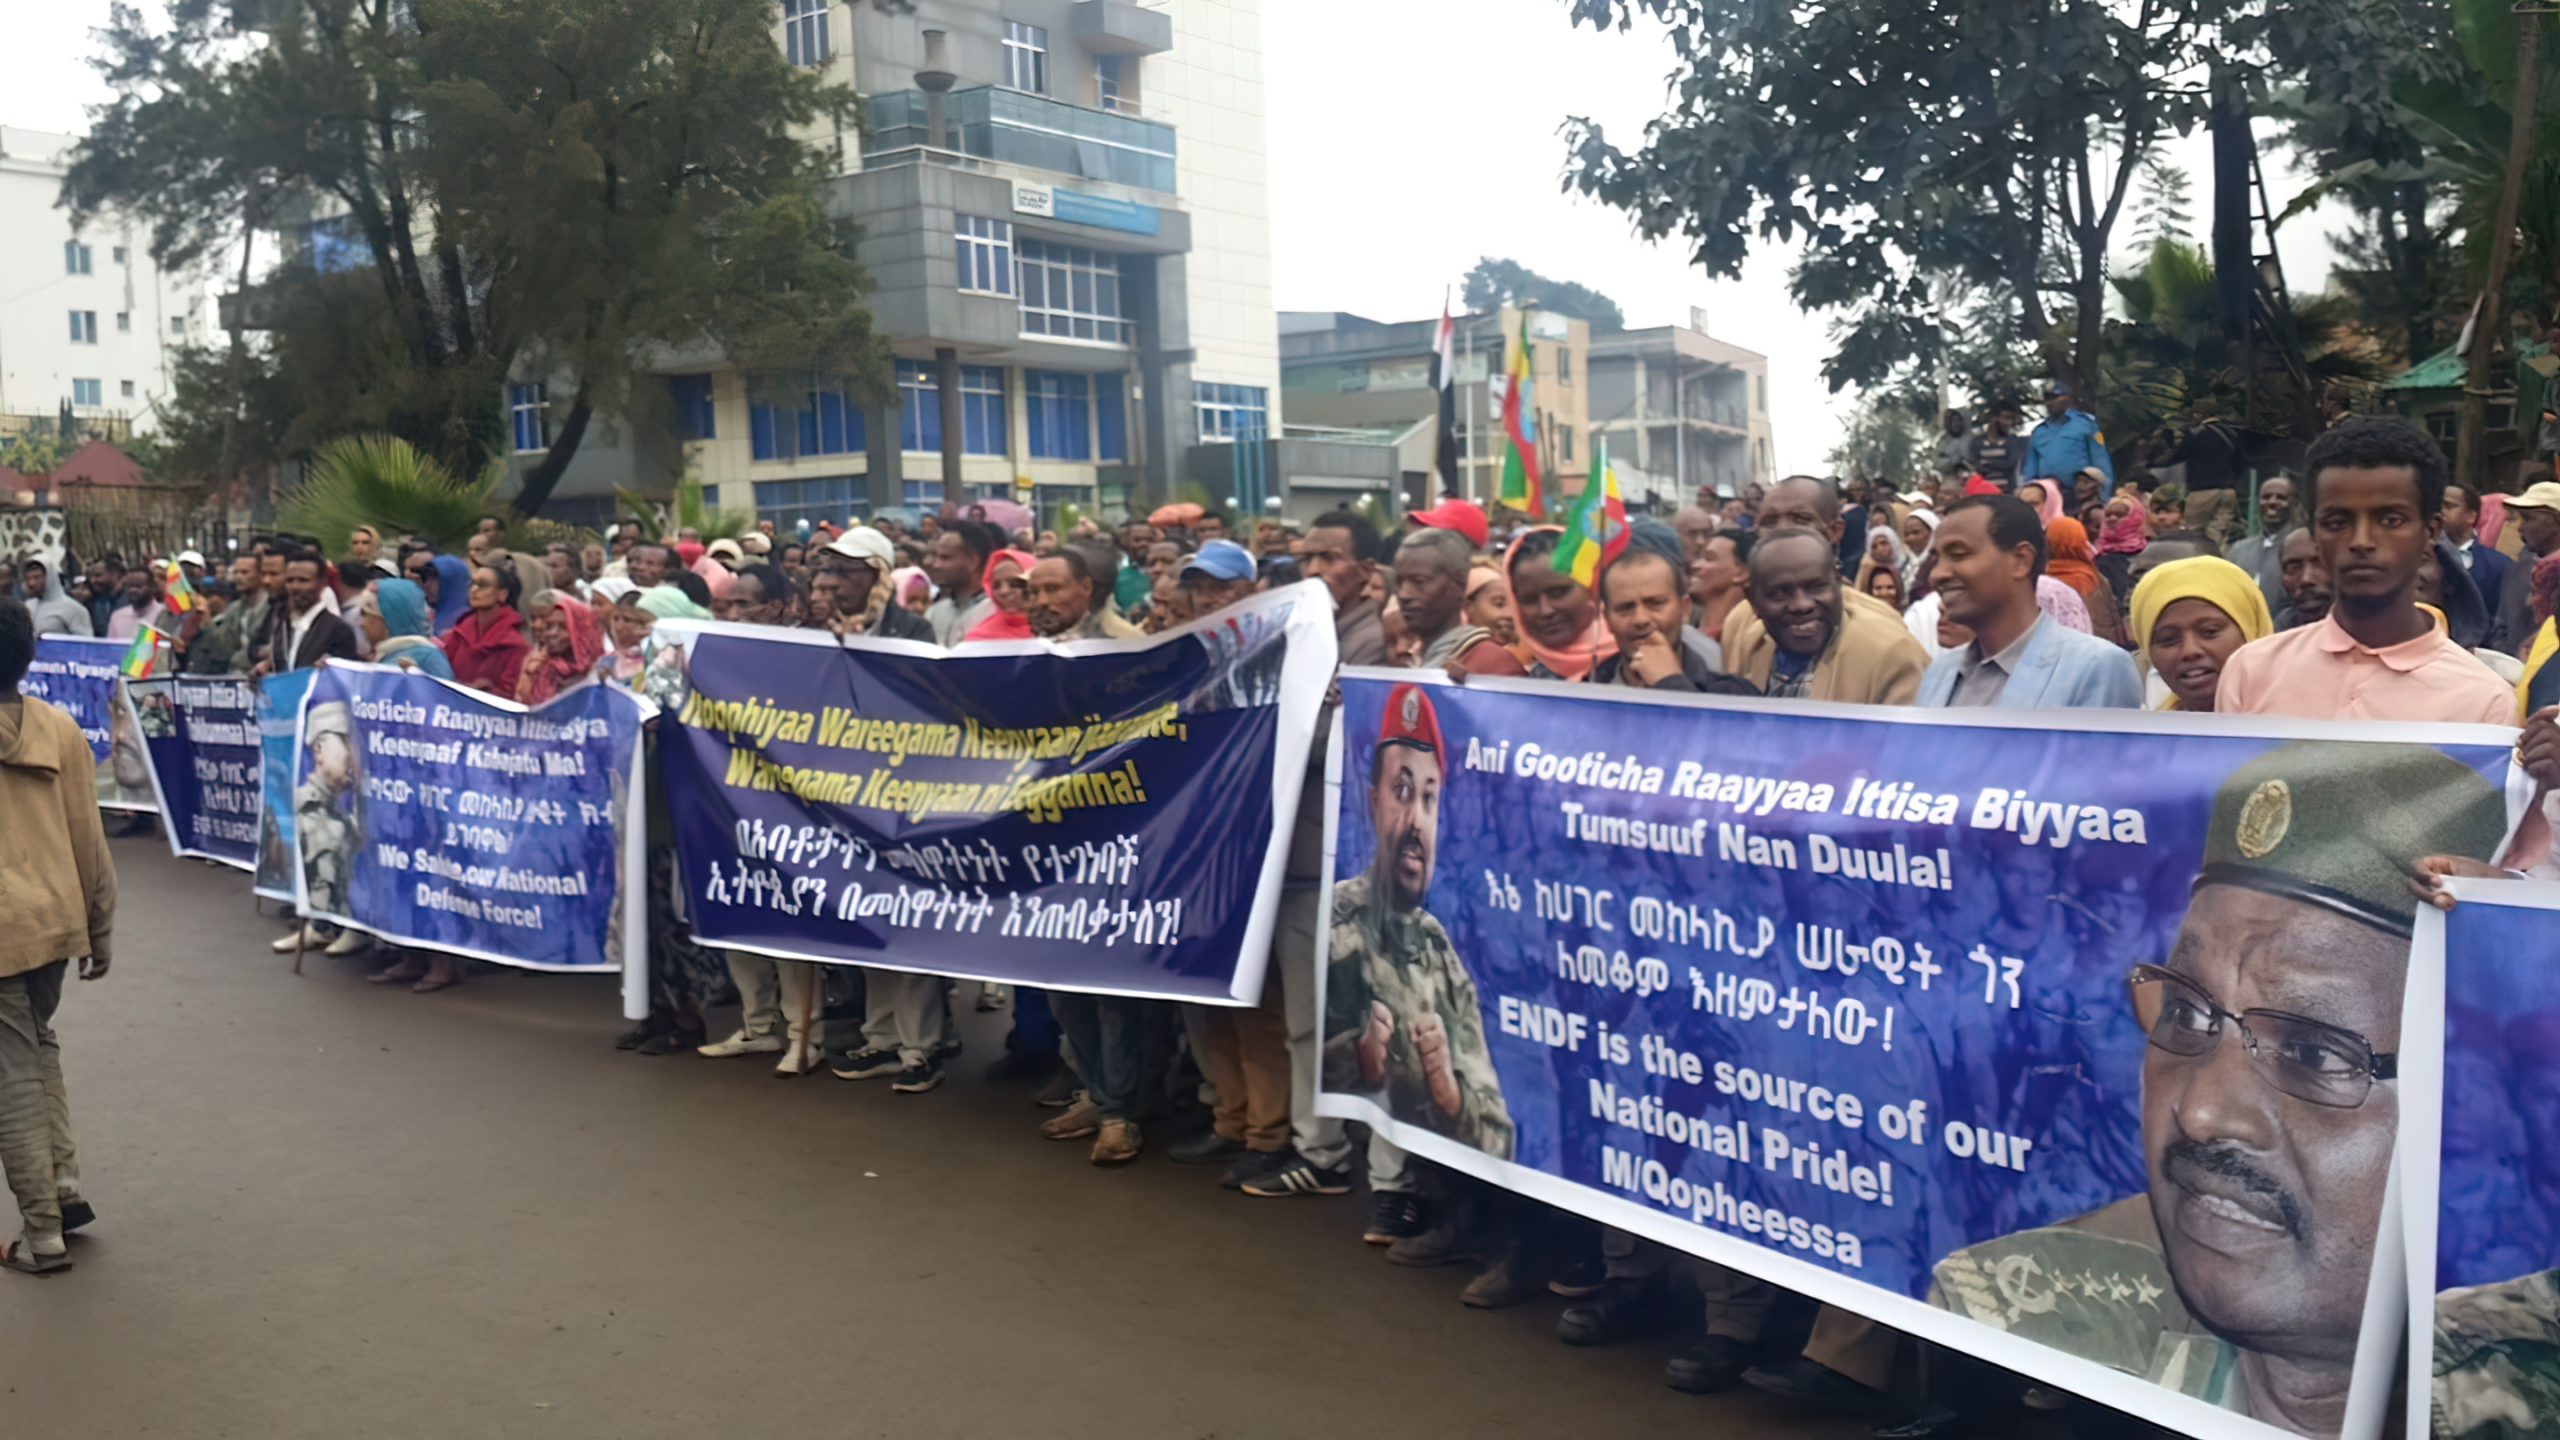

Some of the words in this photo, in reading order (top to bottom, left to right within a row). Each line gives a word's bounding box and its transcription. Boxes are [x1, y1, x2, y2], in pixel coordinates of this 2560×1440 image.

[368, 731, 463, 766] Keenyaaf
[431, 704, 517, 740] Raayyaa
[817, 706, 960, 767] Wareegama
[960, 716, 1082, 773] Keenyaan
[363, 777, 414, 804] ግናው
[858, 768, 975, 824] Keenyaan
[1465, 736, 1510, 775] Ani
[1514, 742, 1665, 794] Gooticha
[1669, 760, 1835, 816] Raayyaa
[1841, 777, 1960, 826] Ittisa
[1970, 787, 2148, 849] Biyyaa
[378, 843, 410, 870] We
[1561, 801, 1708, 858] Tumsuuf
[1718, 821, 1798, 871] Nan
[1808, 833, 1953, 891] Duula!
[482, 899, 544, 931] Force!
[1000, 890, 1182, 948] እንጠብቃታለን!
[1534, 878, 1614, 933] ከሀገር
[1499, 994, 1588, 1052] ENDF
[1597, 1020, 1632, 1067] is
[1640, 1033, 1704, 1086] the
[1713, 1060, 1864, 1130] source
[1878, 1098, 1927, 1146] of
[1944, 1120, 2033, 1173] our
[1588, 1077, 1751, 1164] National
[1762, 1126, 1895, 1208] Pride!
[1601, 1144, 1864, 1269] M/Qopheessa
